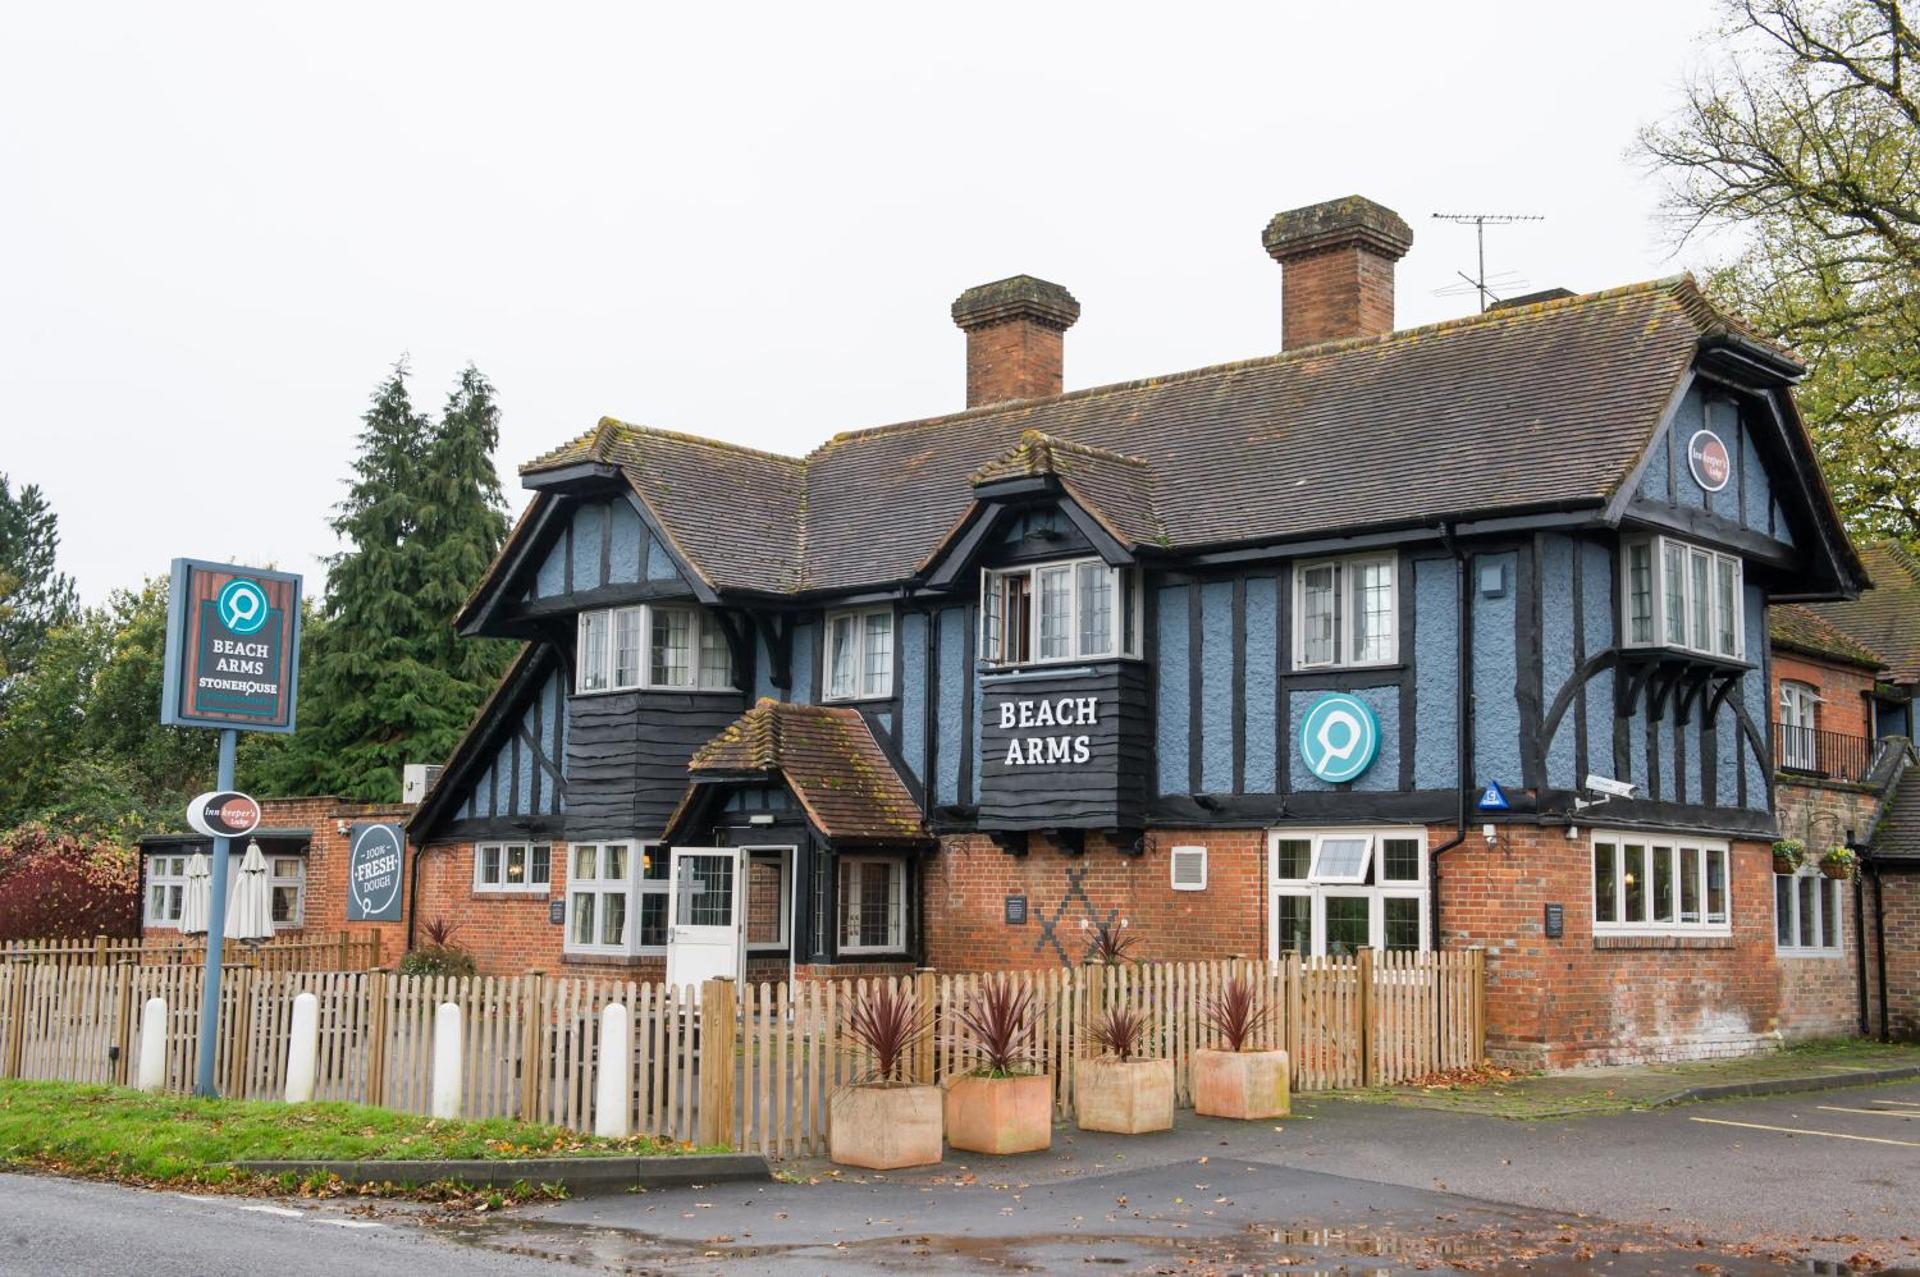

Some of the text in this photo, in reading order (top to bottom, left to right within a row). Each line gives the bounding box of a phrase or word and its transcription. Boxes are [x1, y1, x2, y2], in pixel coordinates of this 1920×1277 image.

[213, 639, 269, 659] BEACH
[216, 658, 264, 675] ARMS
[199, 677, 277, 696] STONEHOUSE
[999, 697, 1098, 729] BEACH
[1004, 735, 1091, 765] ARMS
[357, 854, 395, 882] FRESH
[364, 875, 391, 893] DOUGH
